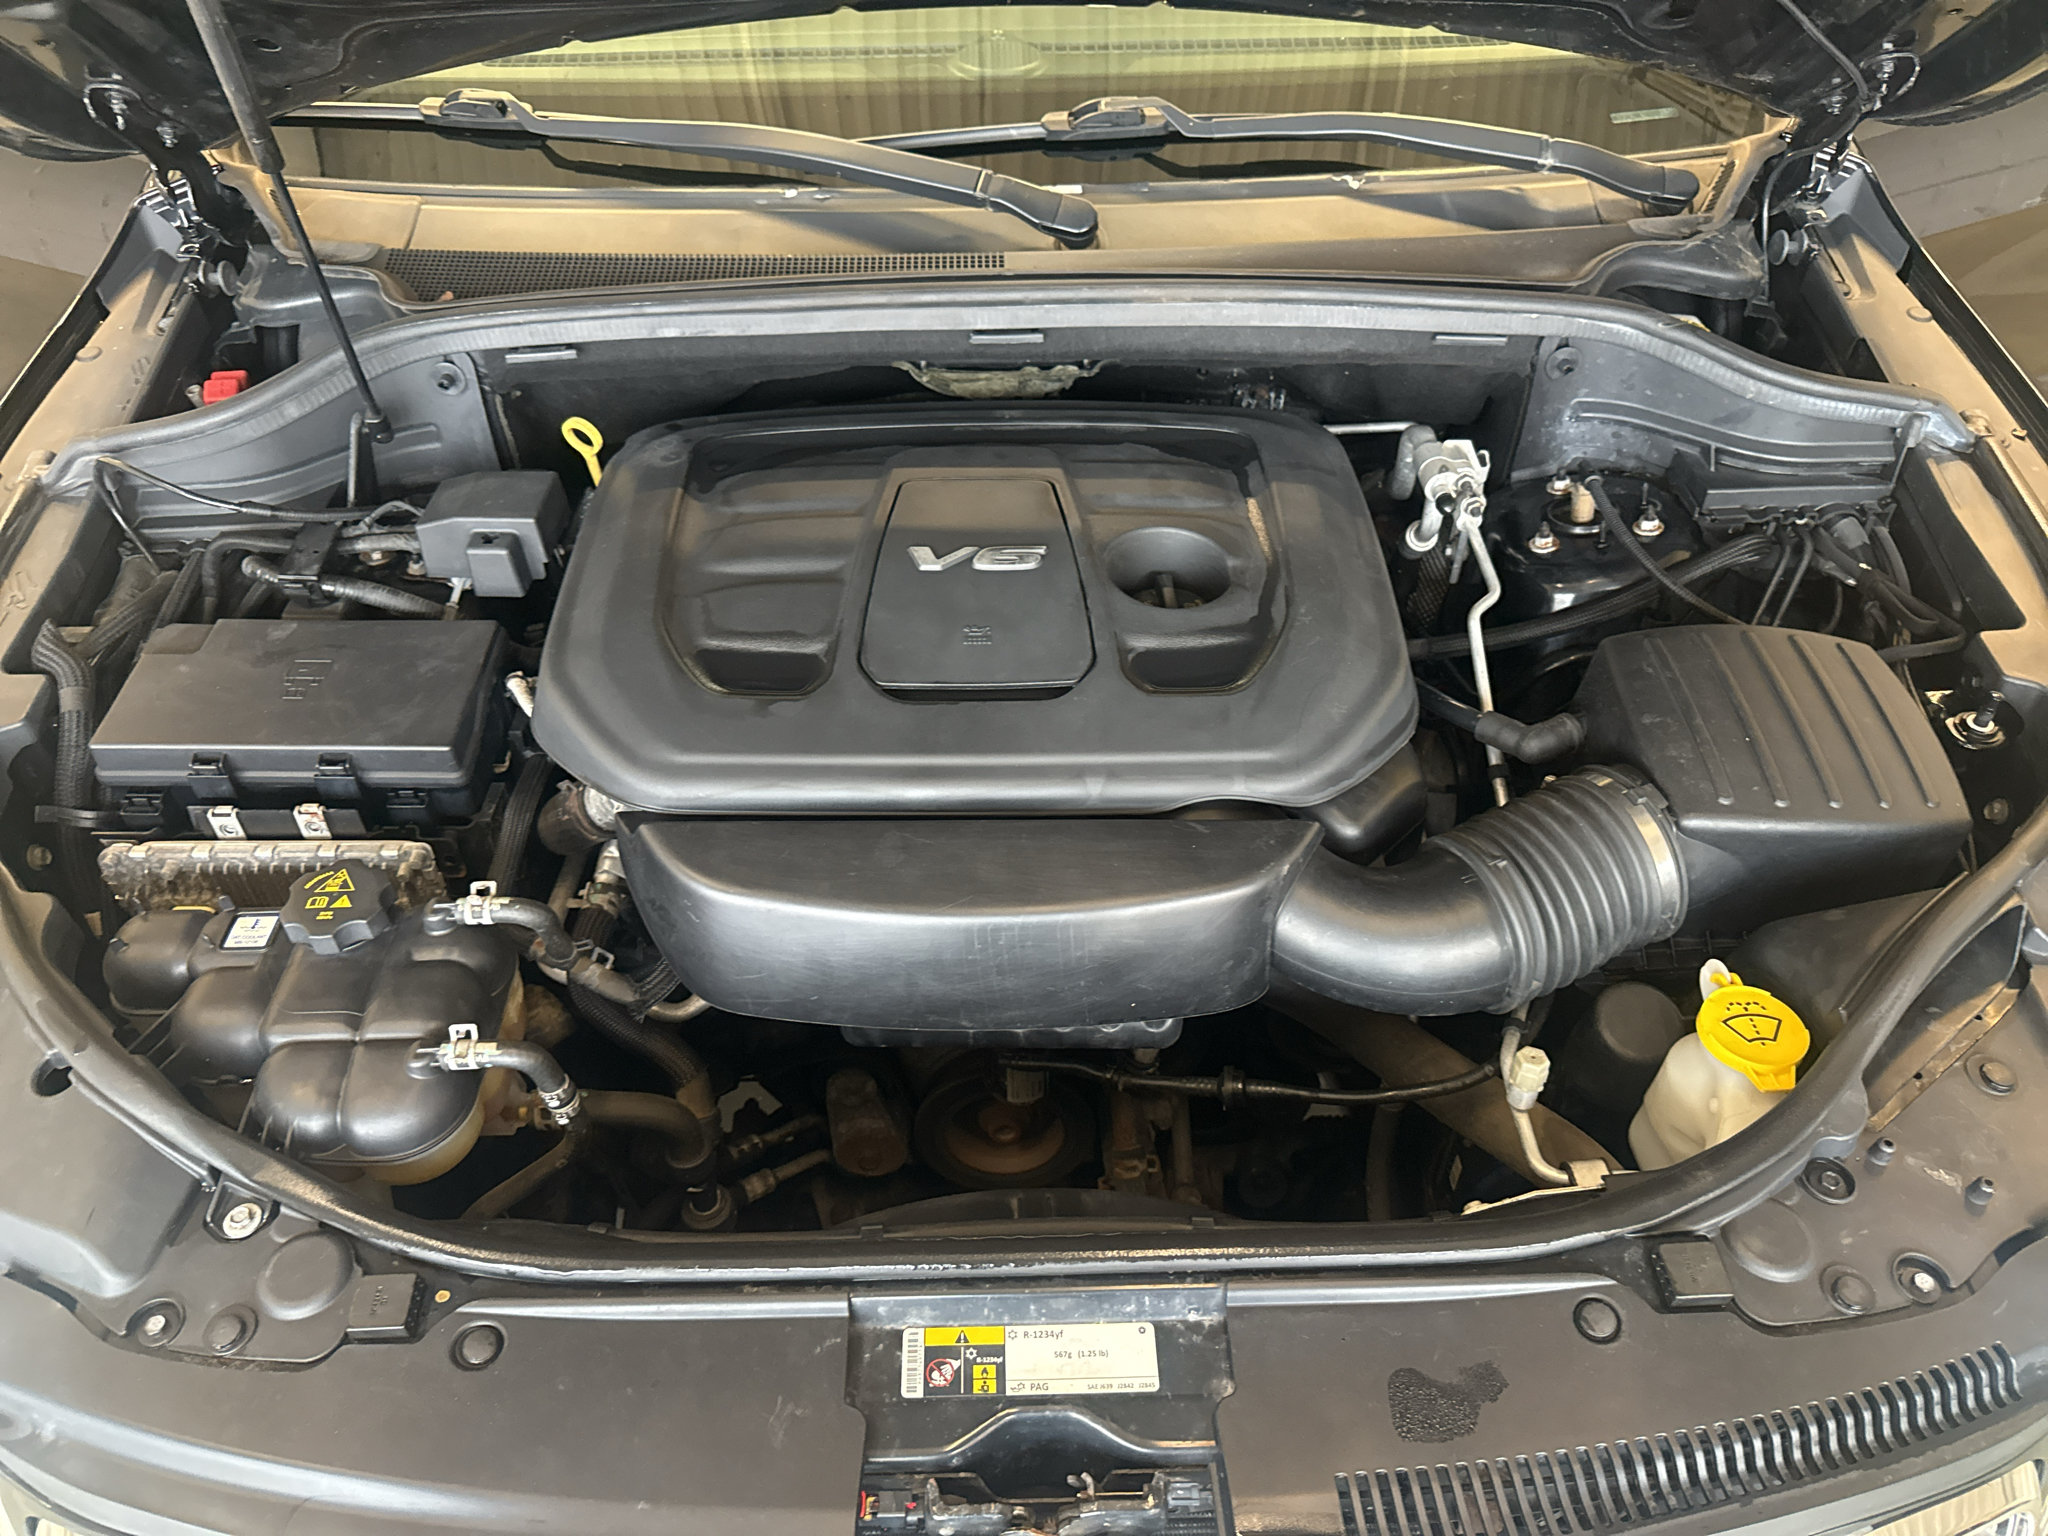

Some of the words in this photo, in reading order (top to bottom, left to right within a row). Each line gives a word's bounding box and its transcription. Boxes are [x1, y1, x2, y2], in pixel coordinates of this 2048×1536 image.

[907, 545, 1047, 571] V6
[1023, 1330, 1064, 1340] R-1234yf
[1054, 1350, 1072, 1359] 567g
[1078, 1350, 1096, 1358] (1.25
[1099, 1350, 1109, 1358] lb)
[1030, 1383, 1049, 1391] PAG
